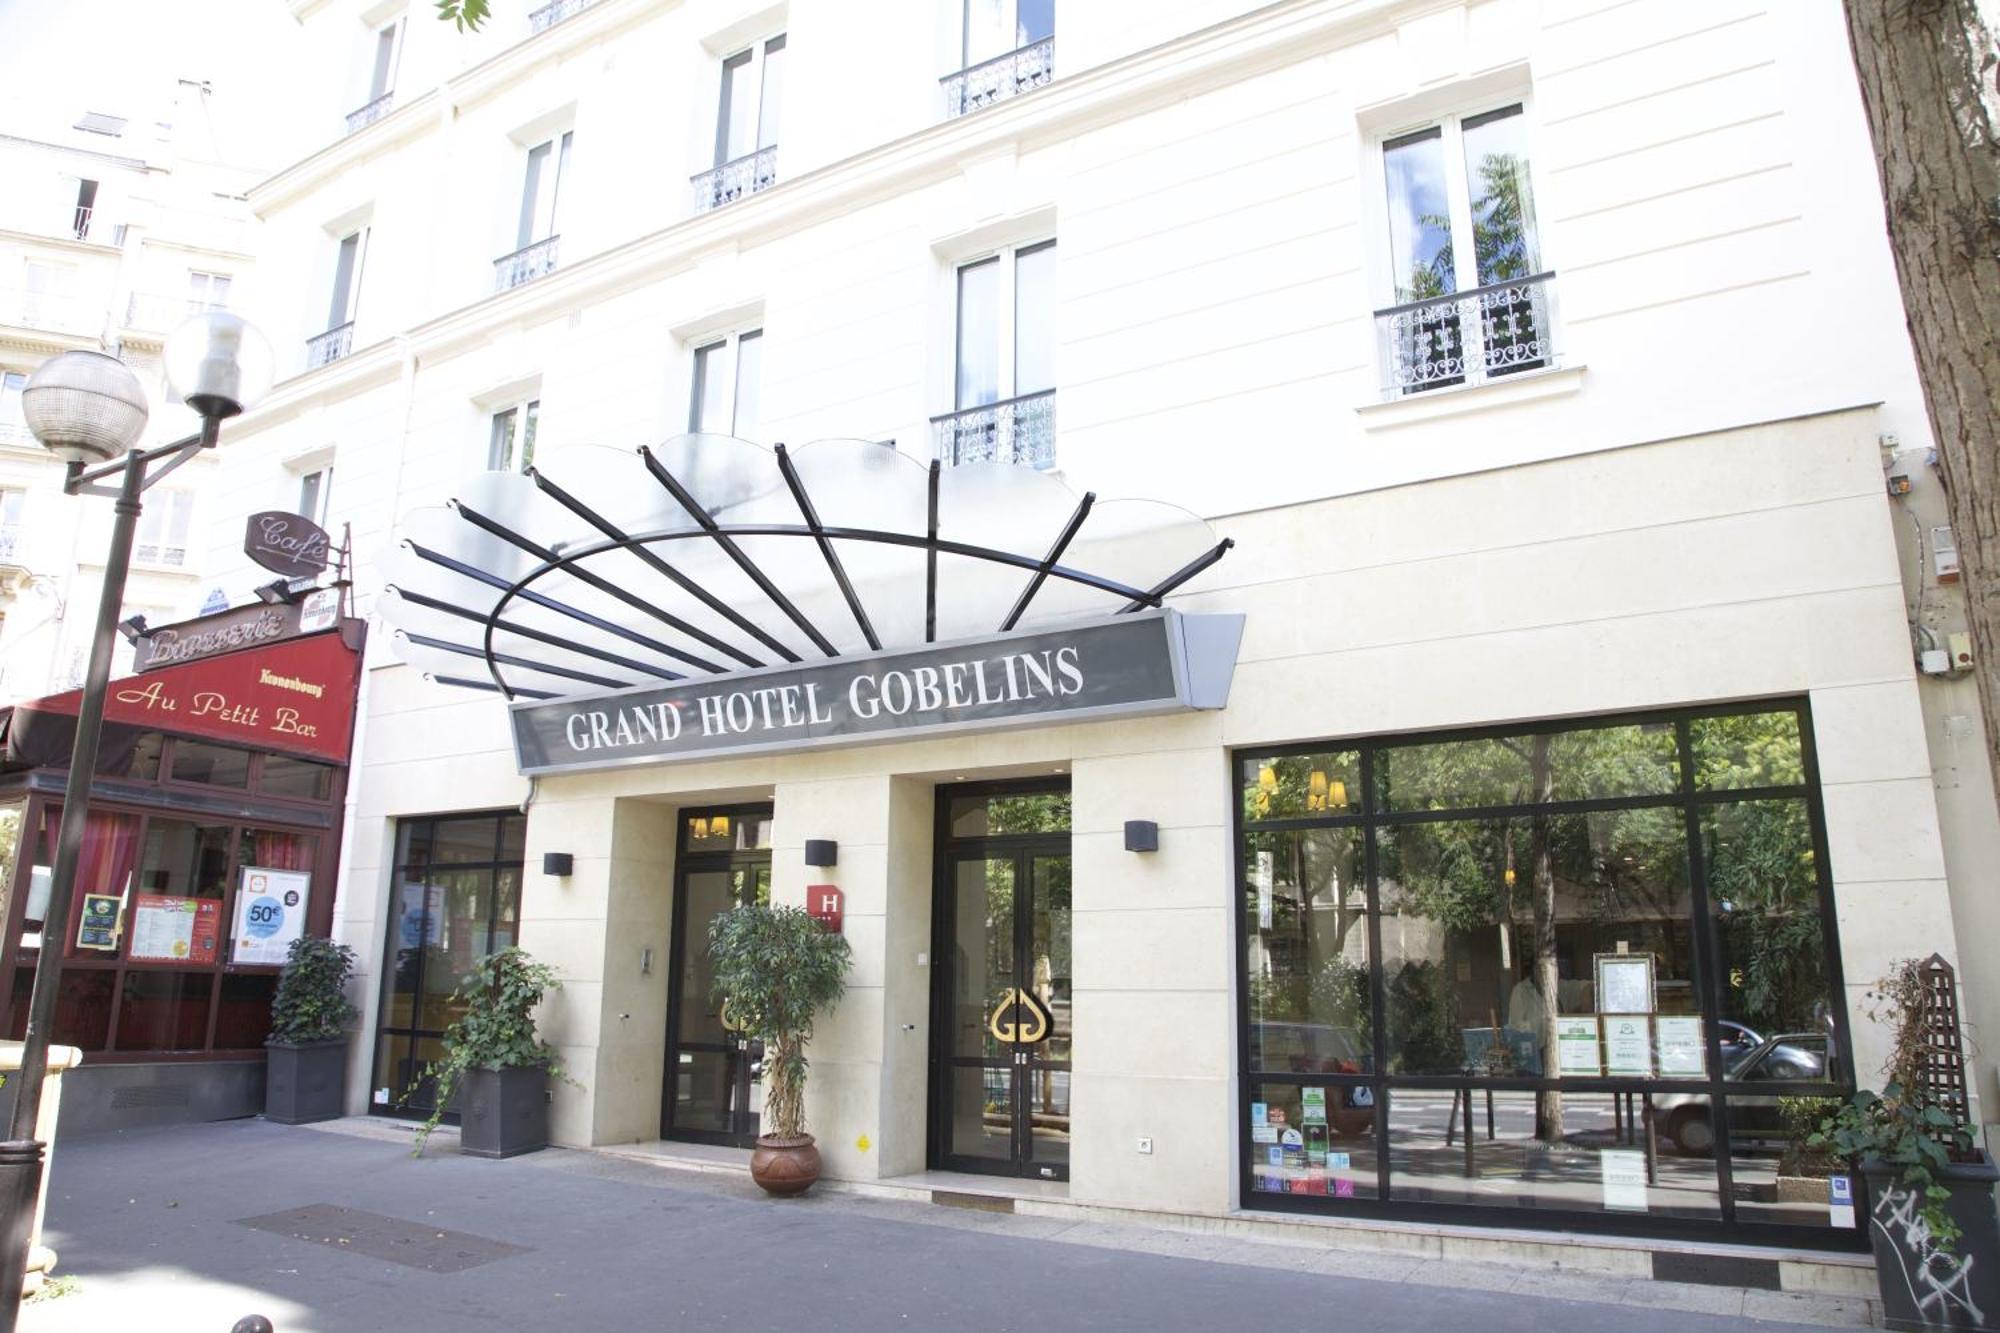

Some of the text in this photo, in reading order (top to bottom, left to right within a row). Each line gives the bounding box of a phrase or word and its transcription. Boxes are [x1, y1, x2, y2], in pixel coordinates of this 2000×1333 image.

[260, 516, 327, 562] Café
[259, 668, 324, 699] Kronenbourg
[566, 646, 1084, 752] GRAND HOTEL GOBELINS
[116, 681, 318, 738] Au Petit Bar
[821, 894, 839, 913] H
